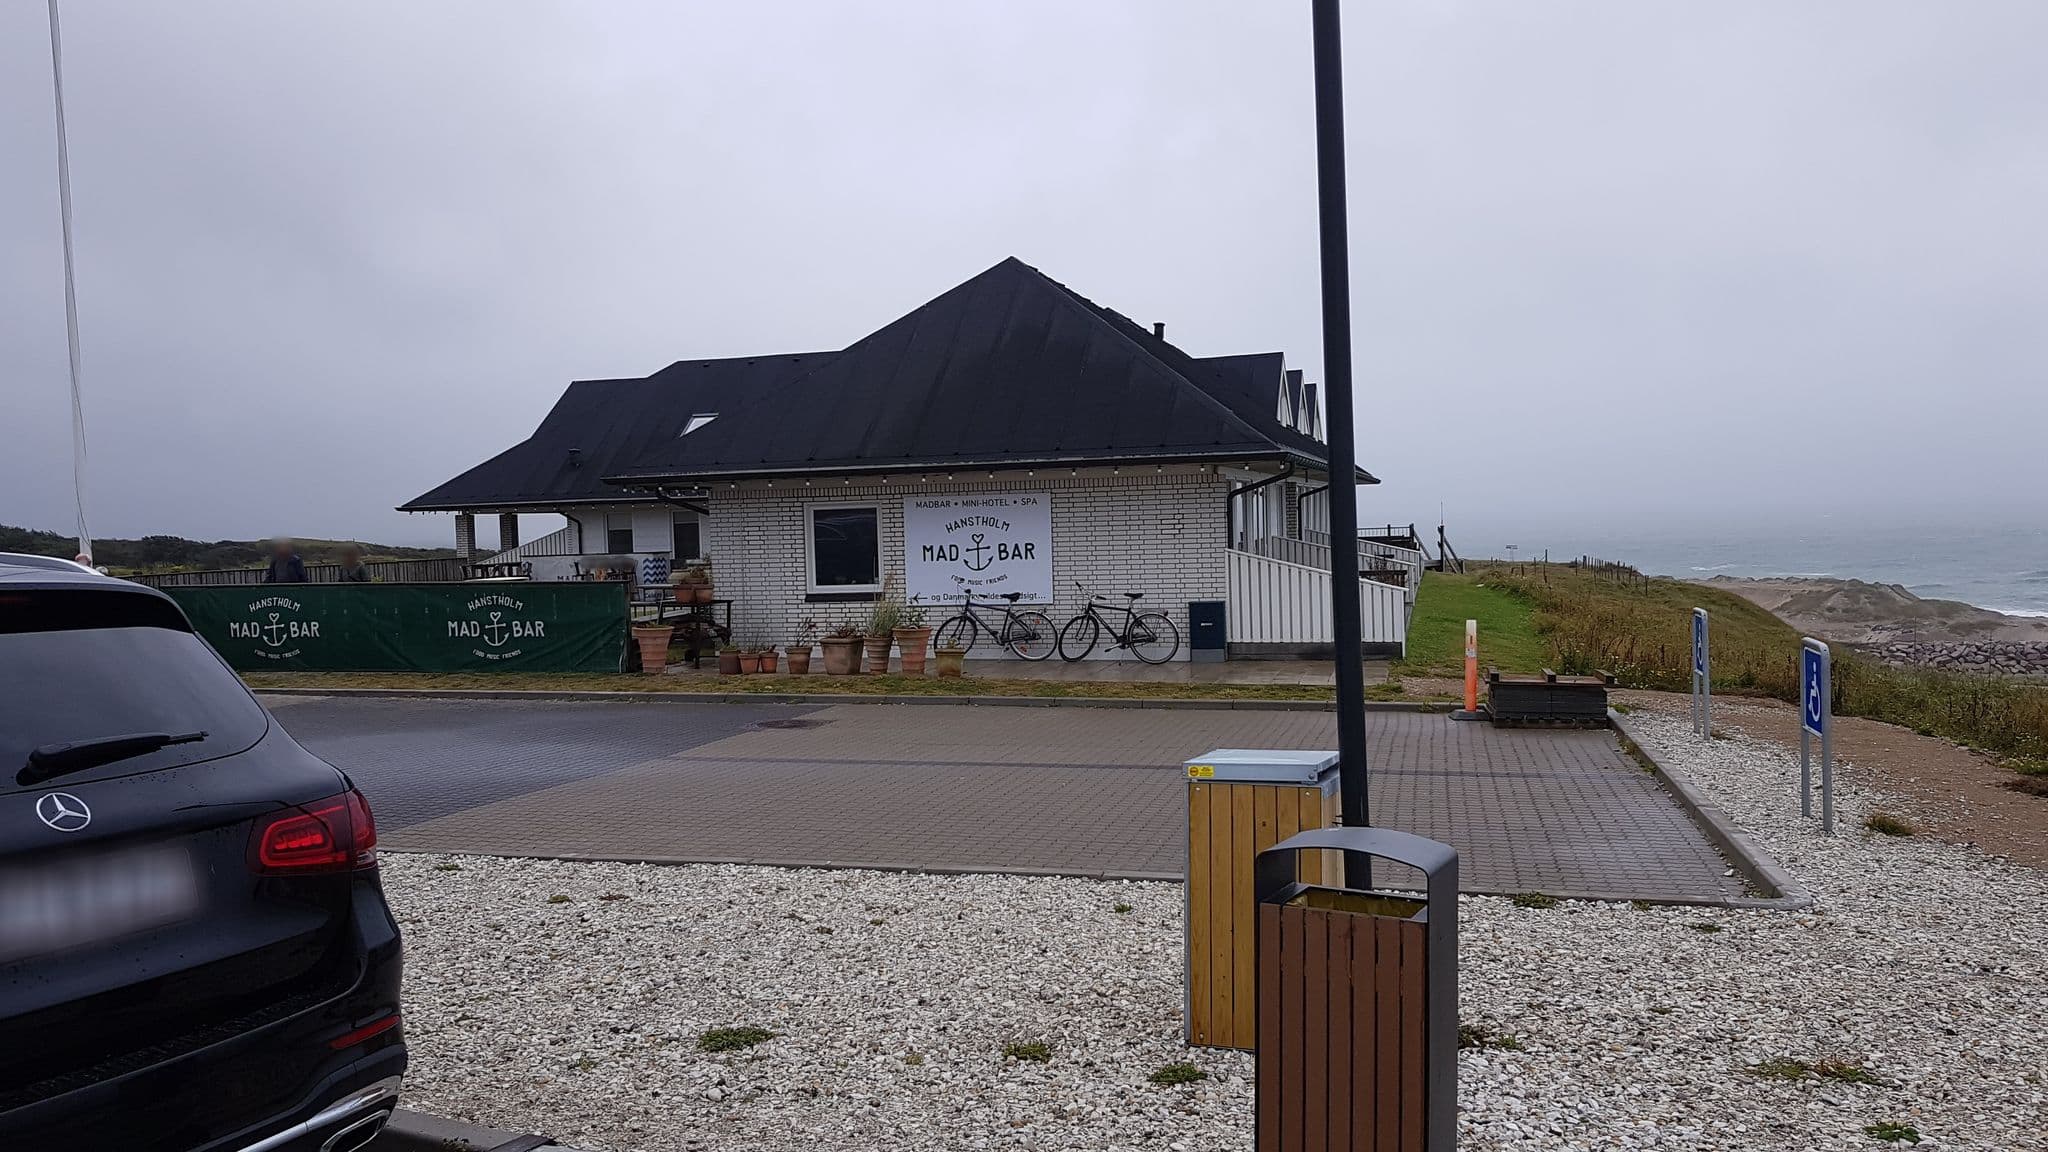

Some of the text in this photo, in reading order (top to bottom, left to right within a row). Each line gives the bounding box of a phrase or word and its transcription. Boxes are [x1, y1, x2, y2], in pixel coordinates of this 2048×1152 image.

[916, 498, 1038, 509] MADBAR MINI-HOTEL SPA
[945, 516, 1010, 533] HANSTHOLM
[922, 543, 1036, 562] MAD BAR
[249, 597, 301, 613] HANSTHOLM
[467, 595, 523, 611] HANSTHOLM
[931, 594, 941, 602] og
[230, 621, 320, 638] MAD BAR
[447, 620, 545, 637] MAD BAR
